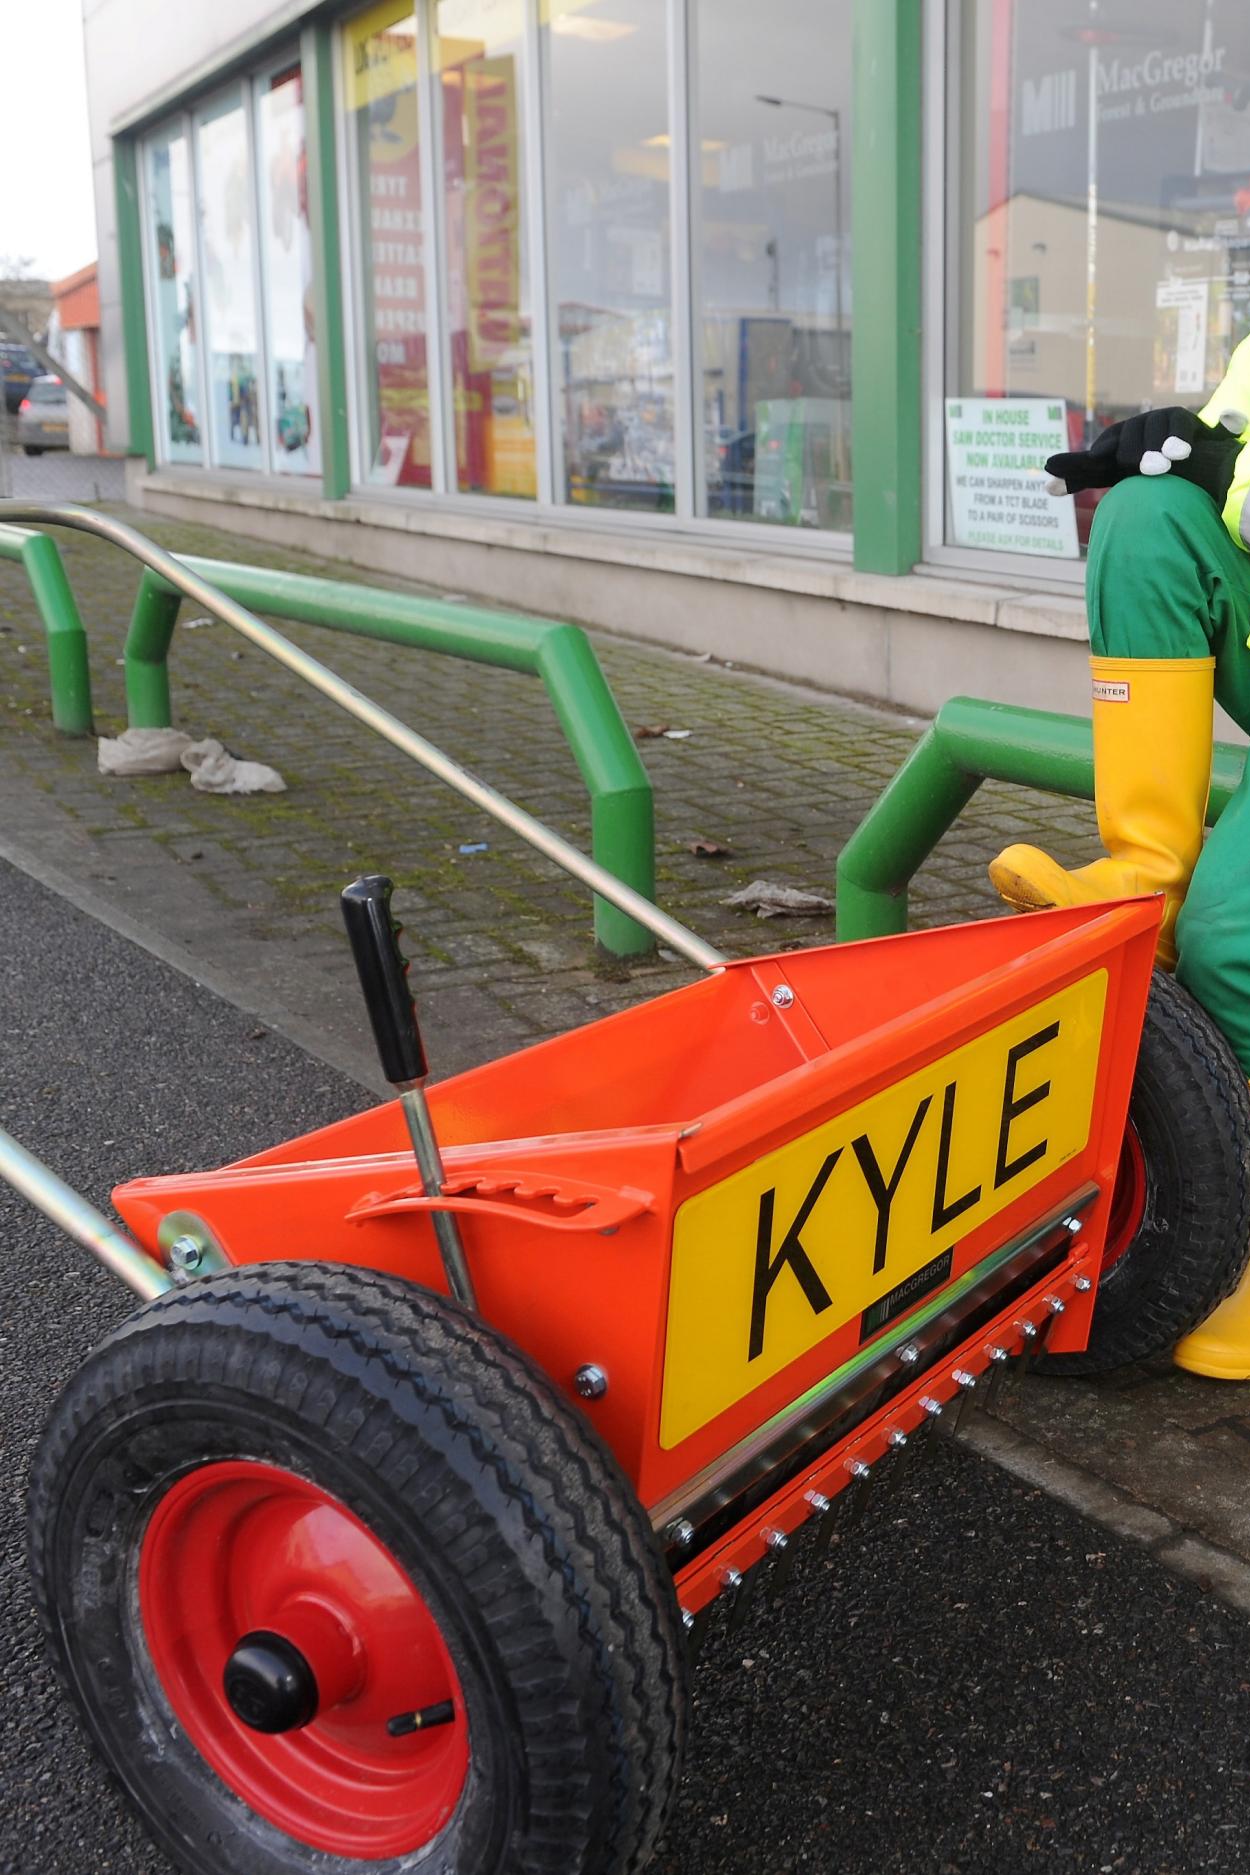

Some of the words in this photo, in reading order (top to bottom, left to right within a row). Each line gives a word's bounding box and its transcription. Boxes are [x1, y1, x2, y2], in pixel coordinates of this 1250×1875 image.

[1098, 47, 1226, 96] MacGregor
[983, 409, 993, 424] IN
[996, 410, 1030, 426] HOUSE
[975, 431, 1016, 447] DOCTOR
[1019, 432, 1062, 449] SERVICE
[966, 453, 989, 467] NOW
[956, 476, 967, 487] WE
[969, 477, 985, 488] CAN
[987, 477, 1024, 491] SHARPEN
[974, 492, 996, 506] FROM
[1022, 497, 1048, 511] BLADE
[967, 508, 978, 521] TO
[987, 510, 1004, 523] PAIR
[1006, 512, 1017, 524] OF
[1019, 513, 1059, 529] SCISSORS
[747, 1020, 1060, 1363] KYLE
[889, 1254, 950, 1305] MACGREGOR
